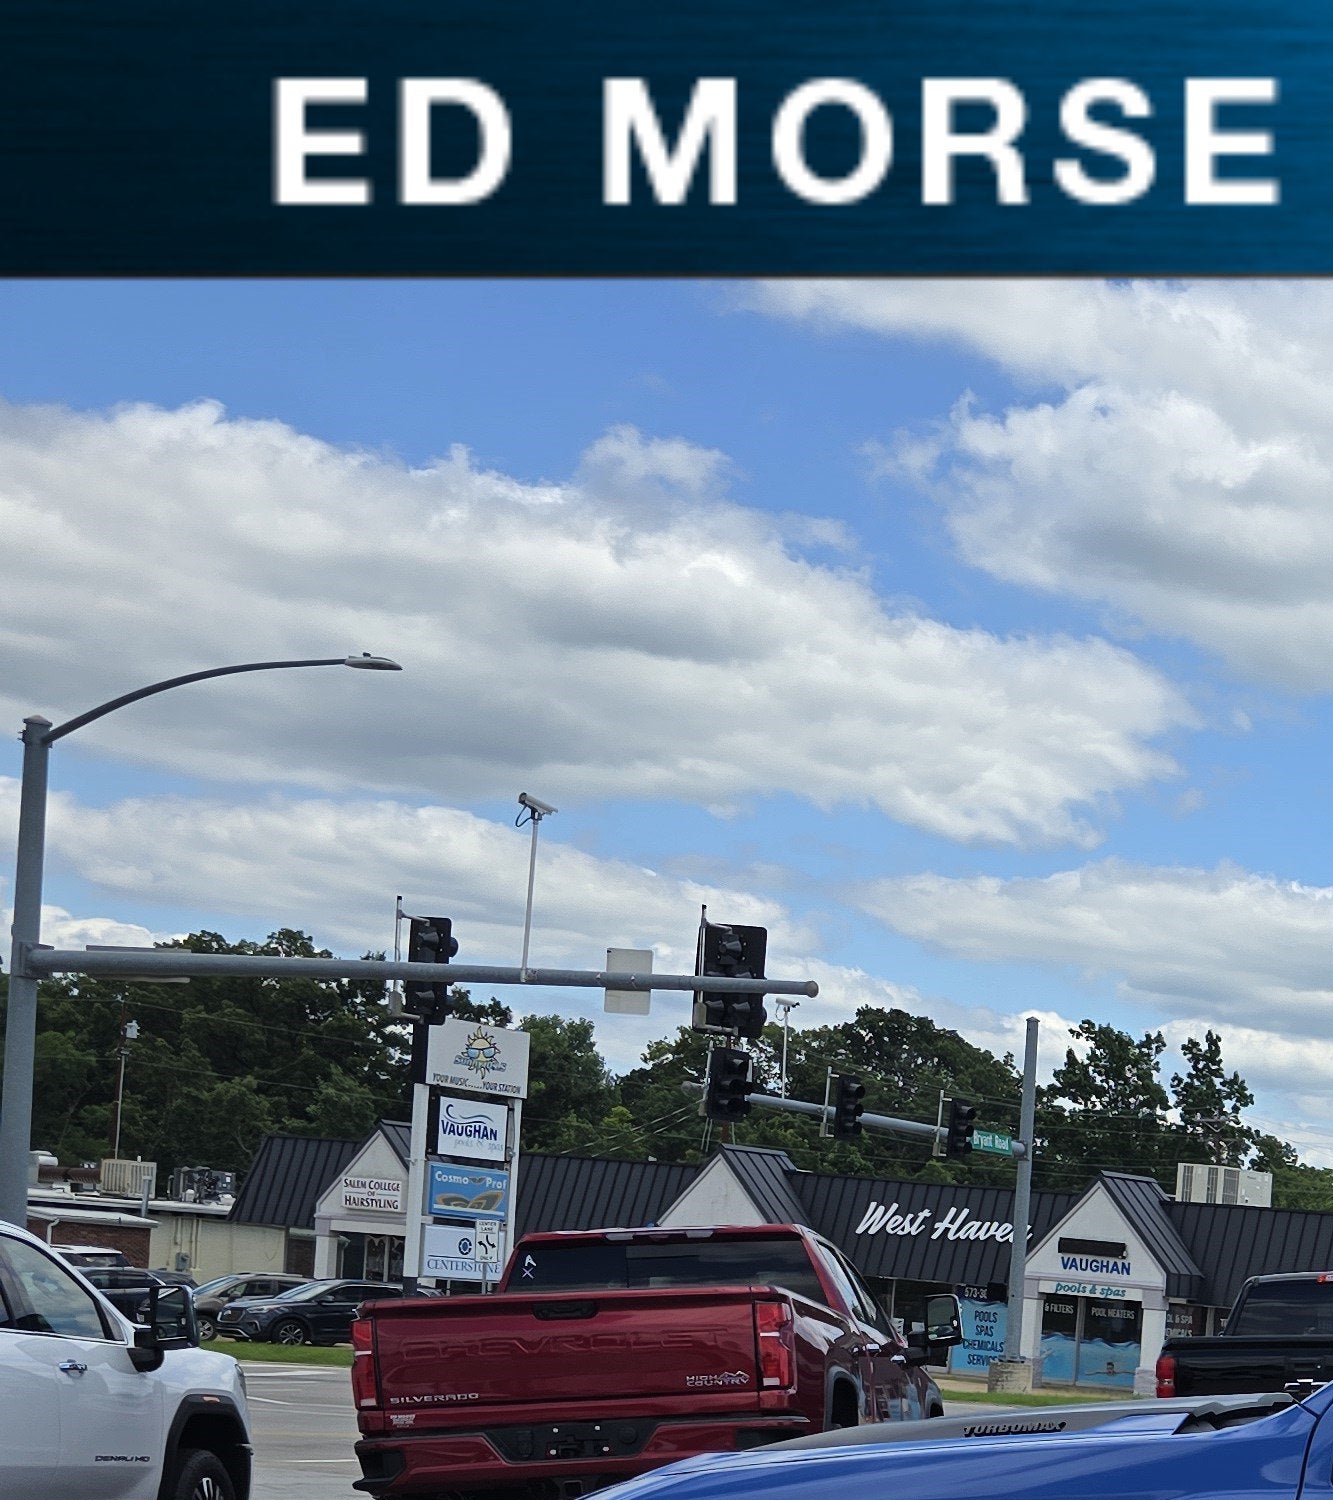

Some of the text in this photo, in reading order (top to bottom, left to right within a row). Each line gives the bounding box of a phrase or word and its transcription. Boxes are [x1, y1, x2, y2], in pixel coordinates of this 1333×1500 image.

[433, 1072, 449, 1083] YOUR
[499, 1083, 521, 1095] STATION
[441, 1120, 498, 1141] VAUGHAN
[973, 1130, 1009, 1150] Bryant Road
[344, 1178, 400, 1192] SALEM COLLEGE
[435, 1170, 507, 1190] Cosmo Prof
[344, 1195, 399, 1210] HAIRSTYLING
[855, 1201, 932, 1236] West
[1060, 1256, 1131, 1276] VAUGHAN
[1055, 1282, 1126, 1298] pools & spas
[1050, 1303, 1074, 1315] FILTERS
[1091, 1307, 1135, 1320] POOL HEATERS
[974, 1310, 998, 1323] POOLS
[975, 1324, 994, 1337] SPAS
[962, 1339, 1005, 1353] CHEMICALS
[686, 1378, 749, 1387] COUNTRY
[390, 1393, 479, 1404] SILVERADO
[963, 1421, 1067, 1438] TURBOMAX
[135, 1455, 151, 1463] HD
